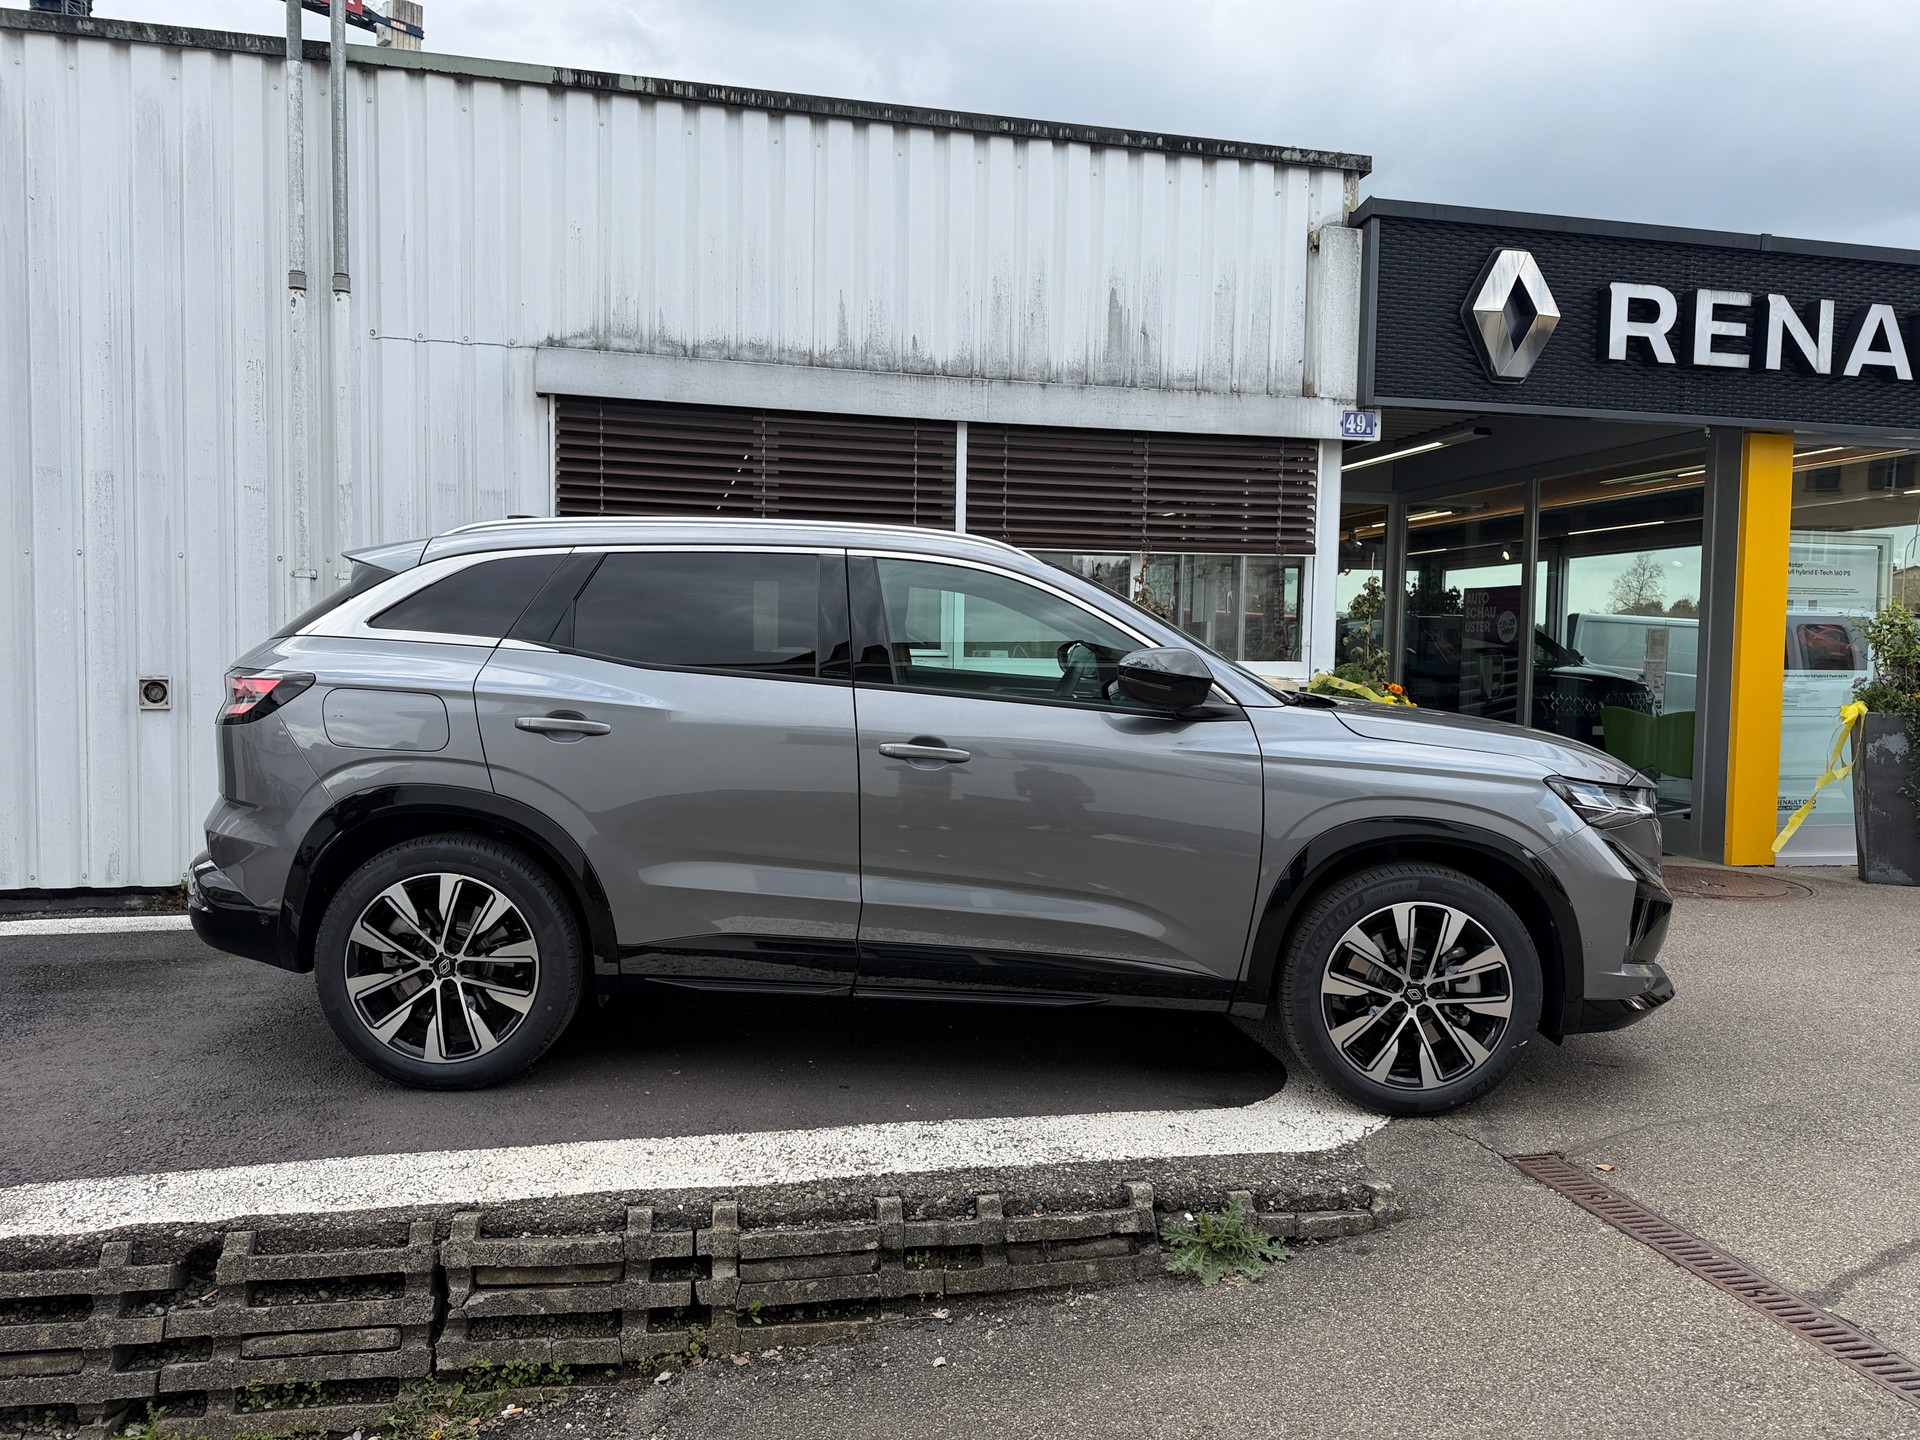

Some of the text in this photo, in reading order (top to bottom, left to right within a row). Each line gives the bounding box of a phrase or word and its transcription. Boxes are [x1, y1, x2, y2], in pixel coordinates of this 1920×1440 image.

[1607, 281, 1914, 381] RENA
[1466, 592, 1489, 604] AUTO
[1465, 606, 1496, 619] SCHAU
[1465, 620, 1491, 632] USTER
